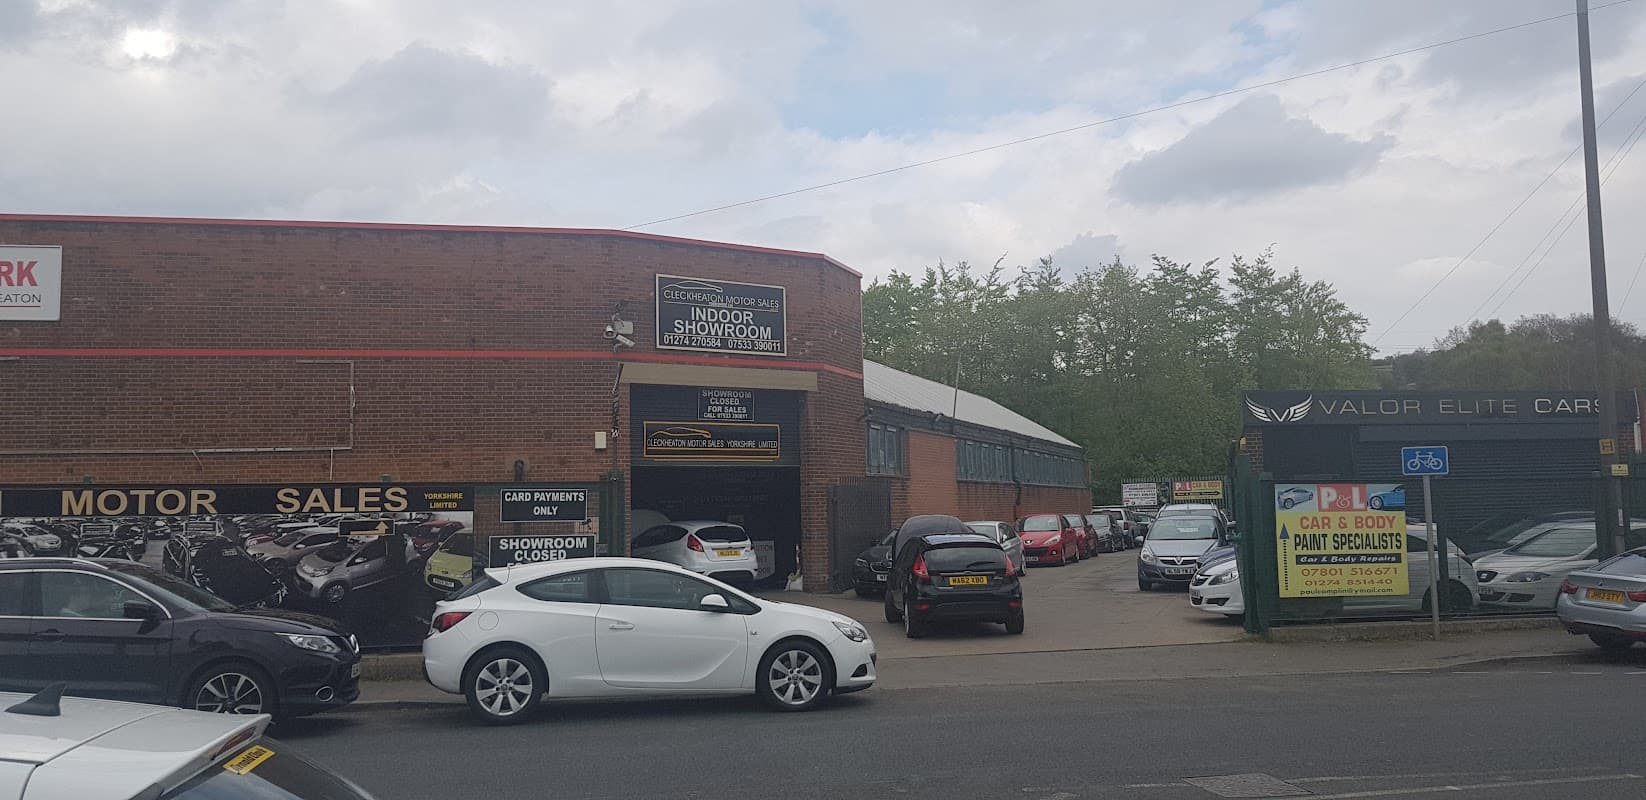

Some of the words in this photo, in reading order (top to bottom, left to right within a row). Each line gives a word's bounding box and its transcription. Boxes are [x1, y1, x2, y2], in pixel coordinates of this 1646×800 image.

[664, 290, 724, 302] CLECKHEATON
[726, 296, 756, 306] MOTOR
[758, 298, 779, 308] SALES
[692, 307, 754, 324] INDOOR
[674, 320, 772, 339] SHOWROOM
[664, 334, 689, 345] 01274
[692, 336, 721, 348] 270584
[728, 339, 752, 350] 07533
[754, 341, 780, 351] 390011
[702, 390, 752, 398] SHOWROOM
[1318, 399, 1421, 415] VALOR
[1439, 399, 1517, 414] ELITE
[648, 438, 686, 447] CLECKHEATON
[687, 439, 706, 448] MOTOR
[708, 440, 724, 448] SALES
[727, 440, 756, 448] YORKSHIRE
[62, 490, 218, 516] MOTOR
[276, 487, 408, 513] SALES
[504, 492, 532, 502] CARD
[534, 492, 584, 502] PAYMENTS
[1320, 486, 1366, 509] P&L
[534, 506, 558, 515] ONLY
[1300, 516, 1331, 529] CAR
[1338, 516, 1348, 529] &
[1354, 516, 1396, 528] BODY
[500, 538, 587, 550] SHOWROOM
[1294, 533, 1328, 551] PAINT
[1332, 532, 1402, 550] SPECIALISTS
[514, 550, 566, 561] CLOSED
[1301, 568, 1343, 577] 07801
[1351, 567, 1398, 576] 516671
